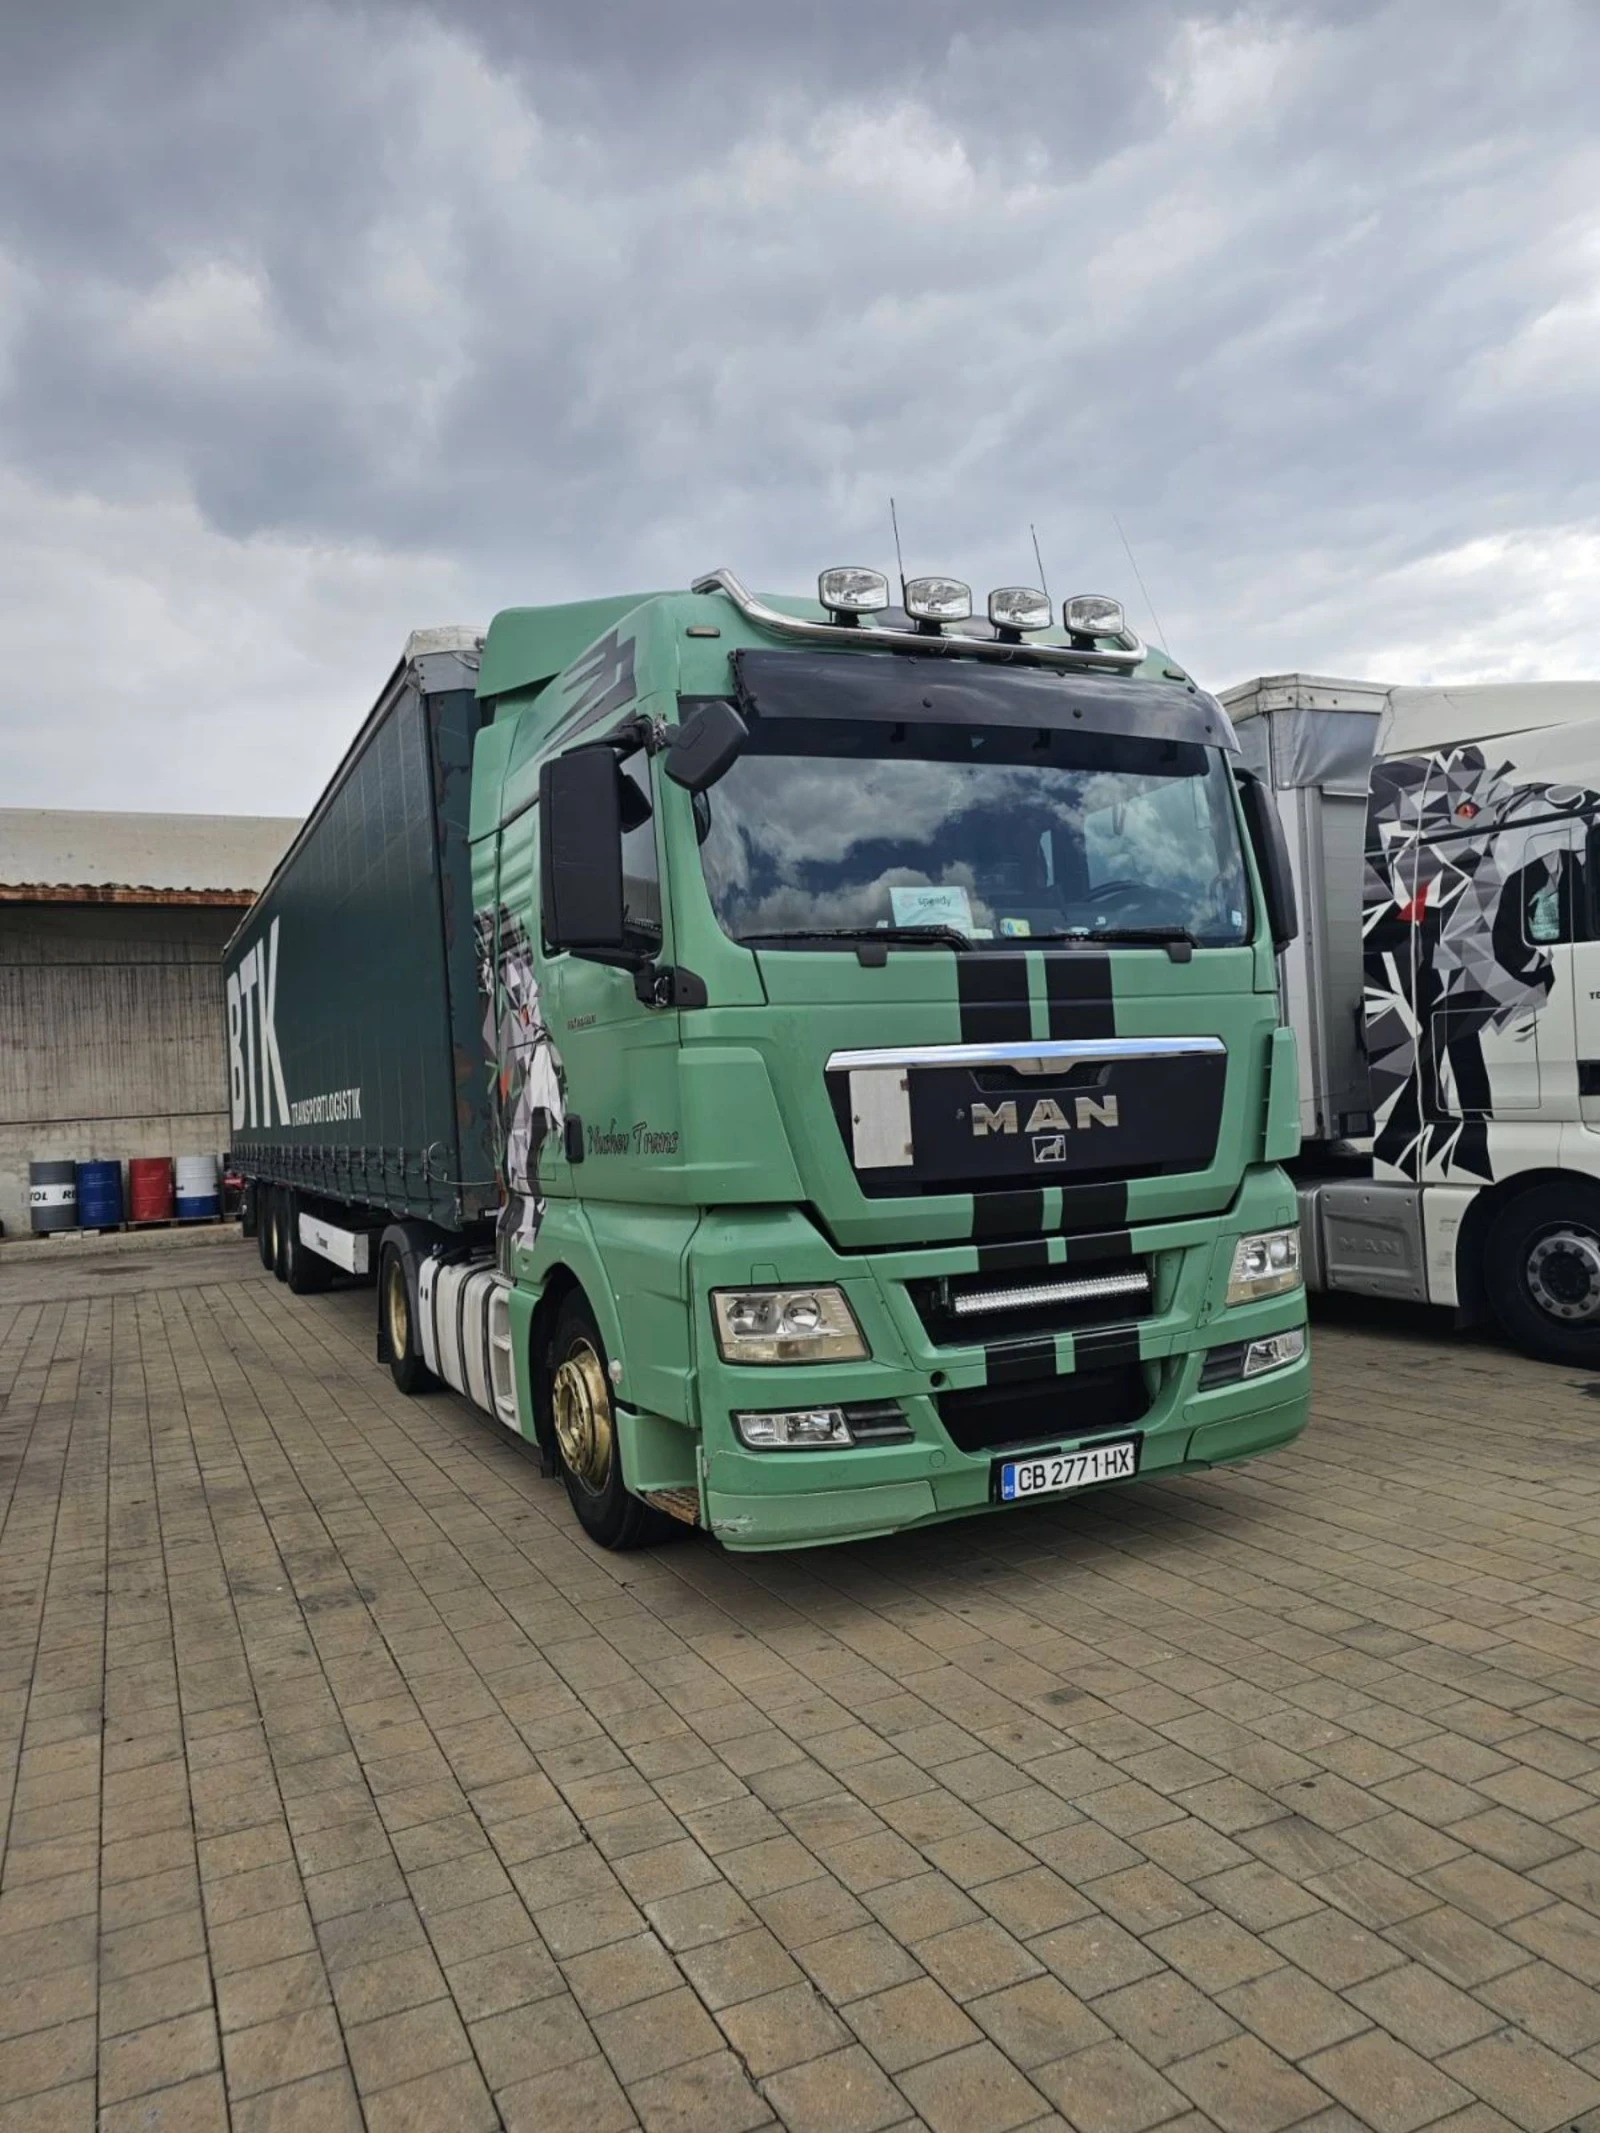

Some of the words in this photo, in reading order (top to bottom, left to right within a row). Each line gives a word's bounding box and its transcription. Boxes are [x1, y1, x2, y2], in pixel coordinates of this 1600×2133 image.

[226, 915, 291, 1131] BTK
[291, 1088, 362, 1127] TRANSPORTLOGISTIK
[970, 1094, 1119, 1136] MAN
[1338, 1236, 1402, 1257] MAN
[1018, 1463, 1047, 1491] CB
[1050, 1453, 1099, 1486] 2771
[1104, 1447, 1130, 1476] HX
